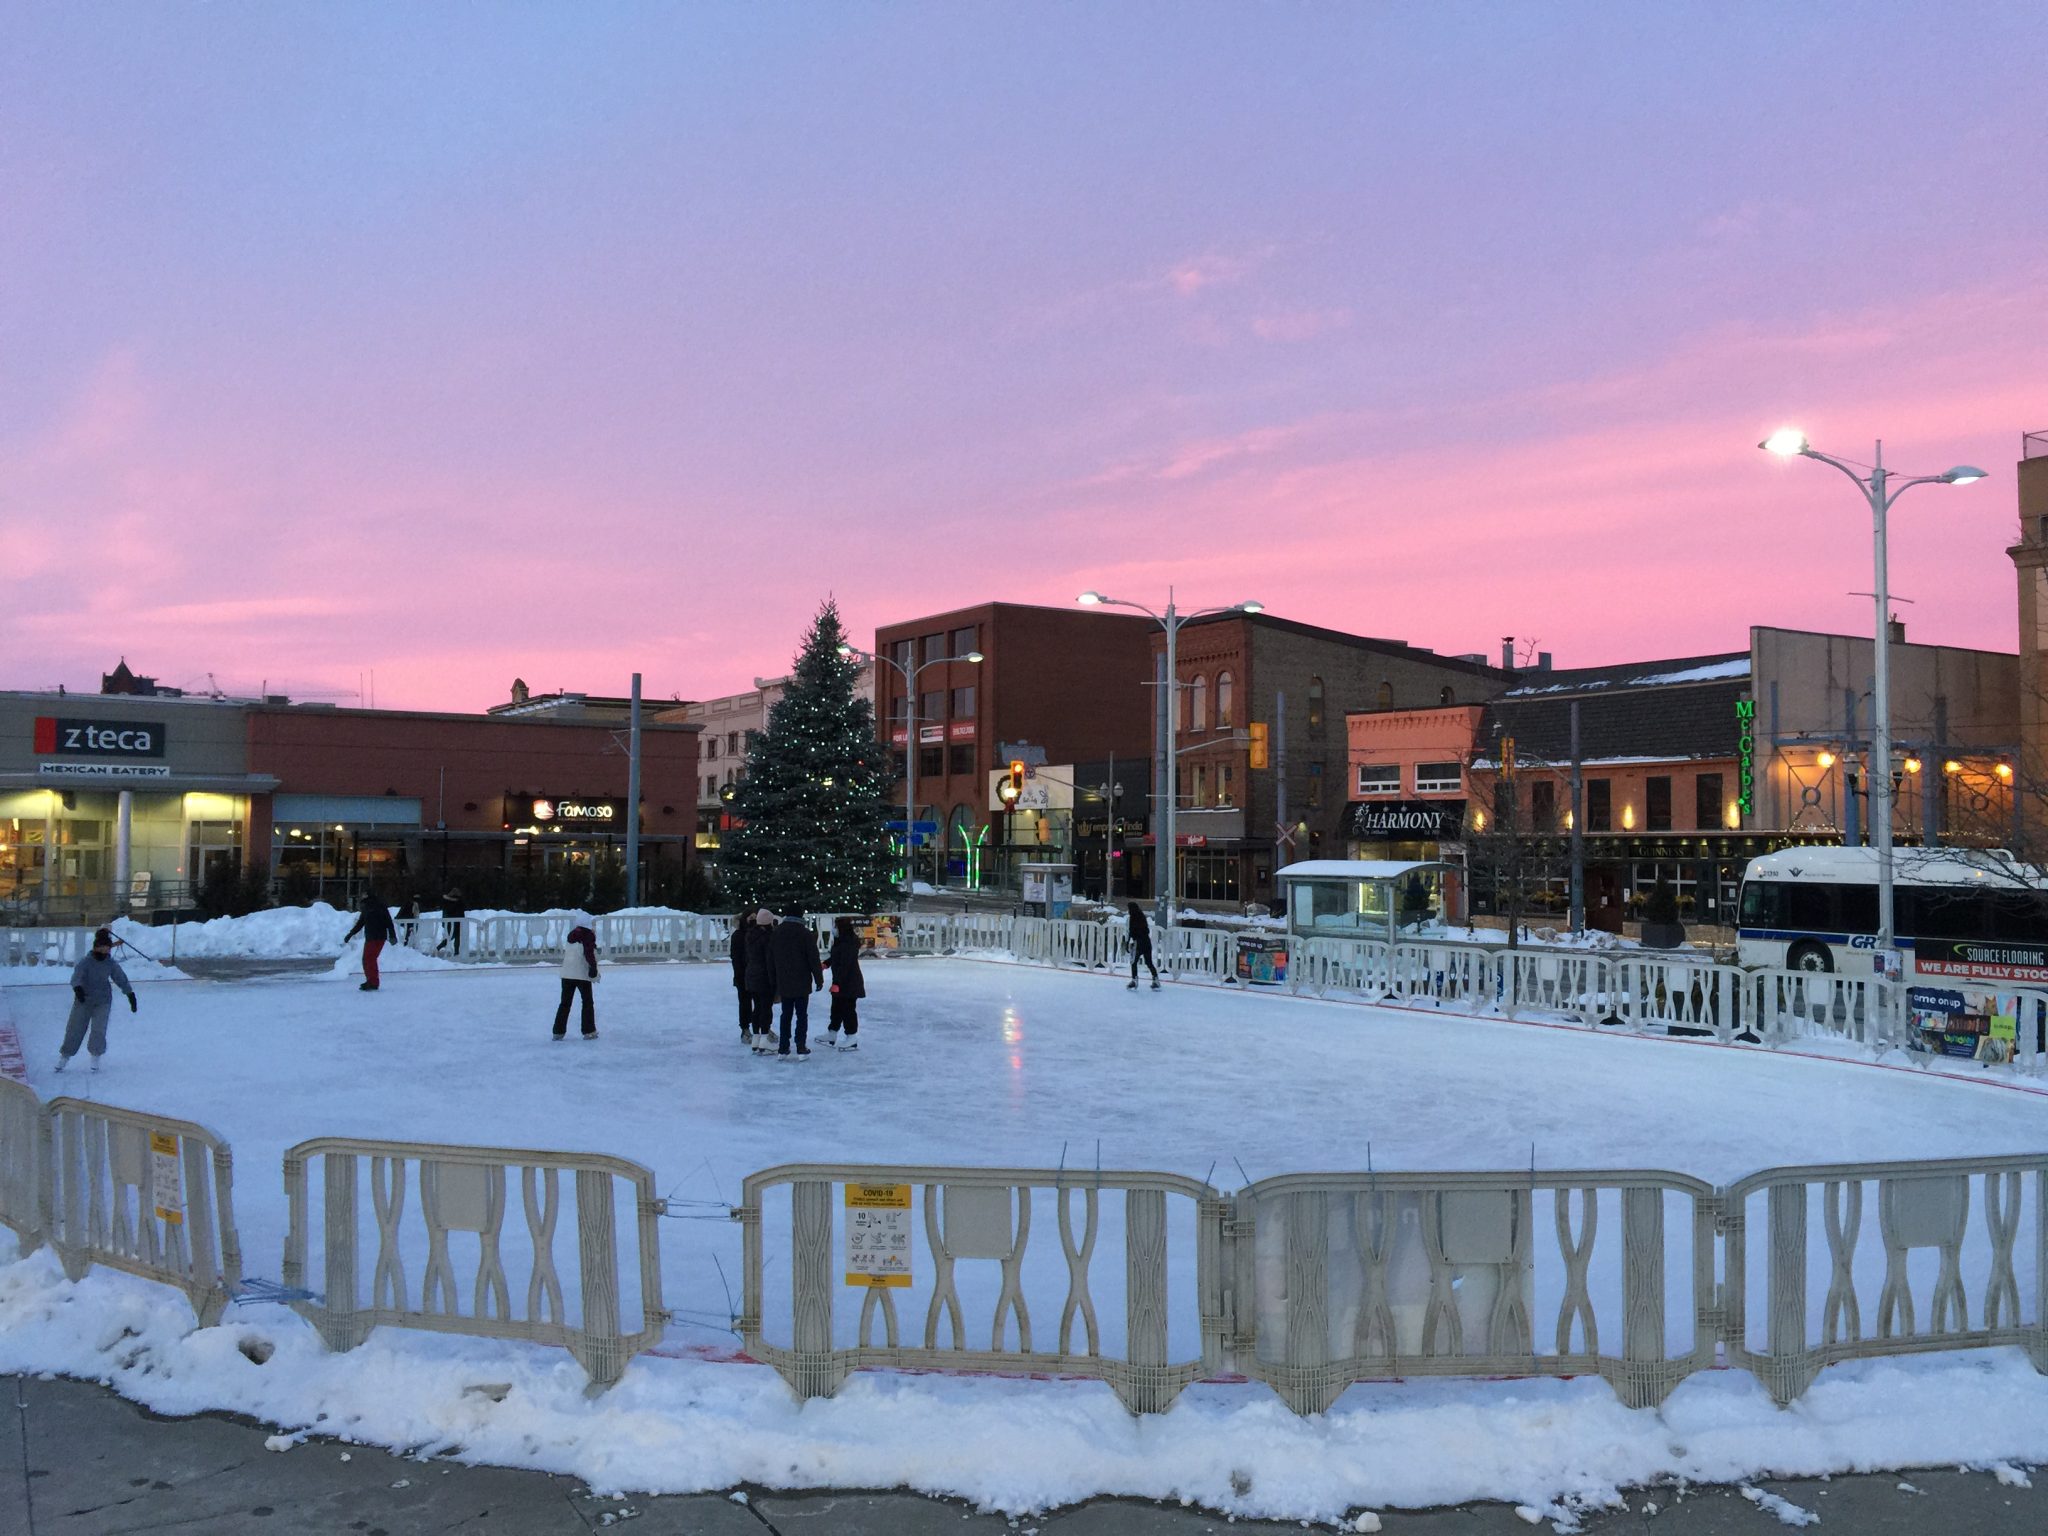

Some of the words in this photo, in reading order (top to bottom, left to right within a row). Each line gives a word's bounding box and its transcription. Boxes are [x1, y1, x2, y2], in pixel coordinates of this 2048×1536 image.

[43, 765, 107, 775] MEXICAN
[111, 767, 167, 776] EATERY
[1366, 812, 1445, 829] HARMONY
[1639, 847, 1684, 857] GUINNESS
[1851, 935, 1878, 949] GR
[1967, 947, 2000, 963] SOURCE
[2001, 950, 2044, 966] FLOORING
[1921, 961, 1942, 973] WE
[1944, 963, 1970, 975] ARE
[1972, 964, 2012, 978] FULLY
[1913, 995, 1936, 1004] ome
[1938, 998, 1949, 1007] on
[1950, 1000, 1961, 1009] up
[863, 1189, 893, 1197] COVID-19
[858, 1212, 866, 1220] 10
